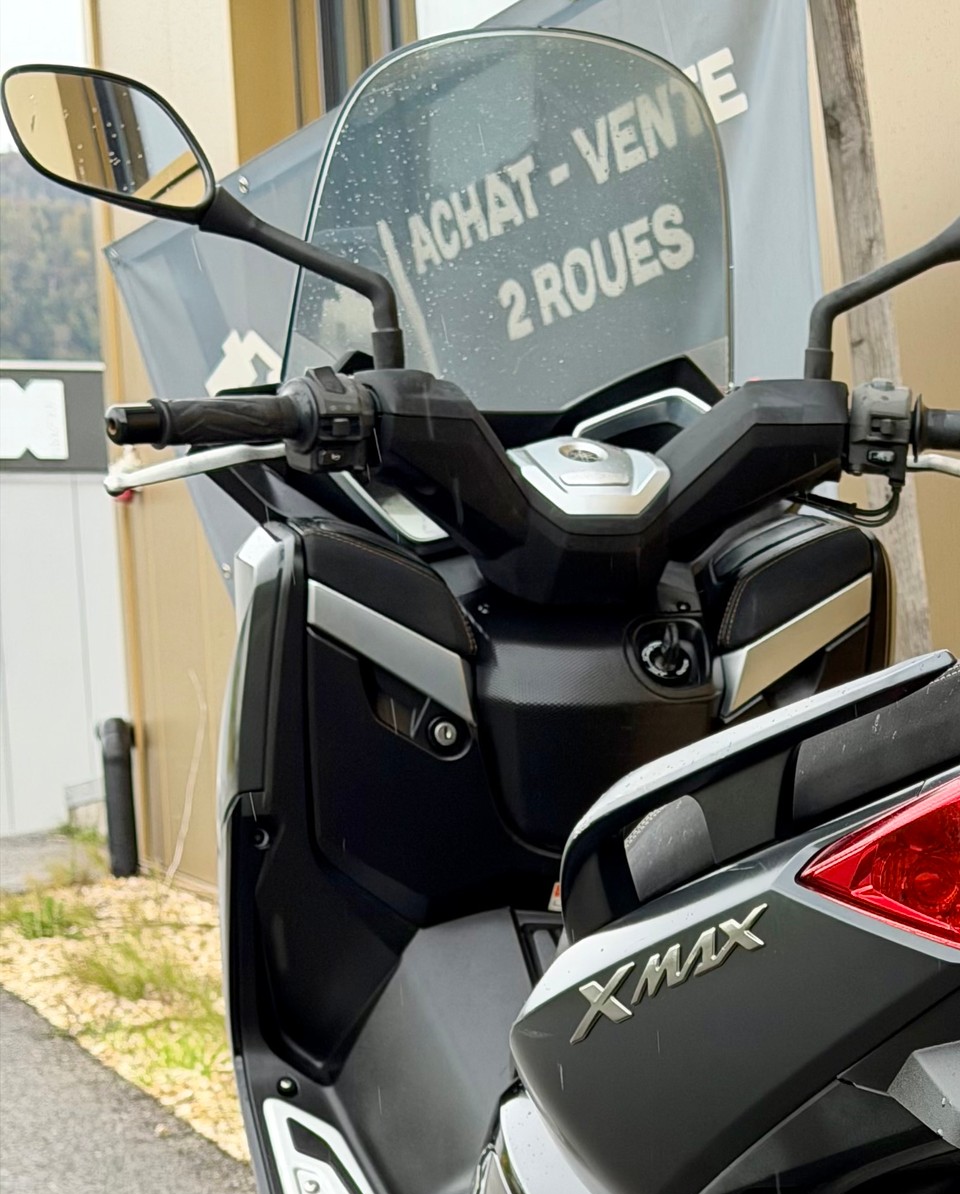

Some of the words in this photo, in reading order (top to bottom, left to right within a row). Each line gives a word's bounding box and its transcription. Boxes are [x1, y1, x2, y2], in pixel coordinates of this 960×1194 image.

[408, 154, 539, 275] ACHAT
[548, 162, 571, 187] -
[571, 47, 749, 185] VENTE
[498, 278, 535, 342] 2
[531, 203, 695, 326] ROUES
